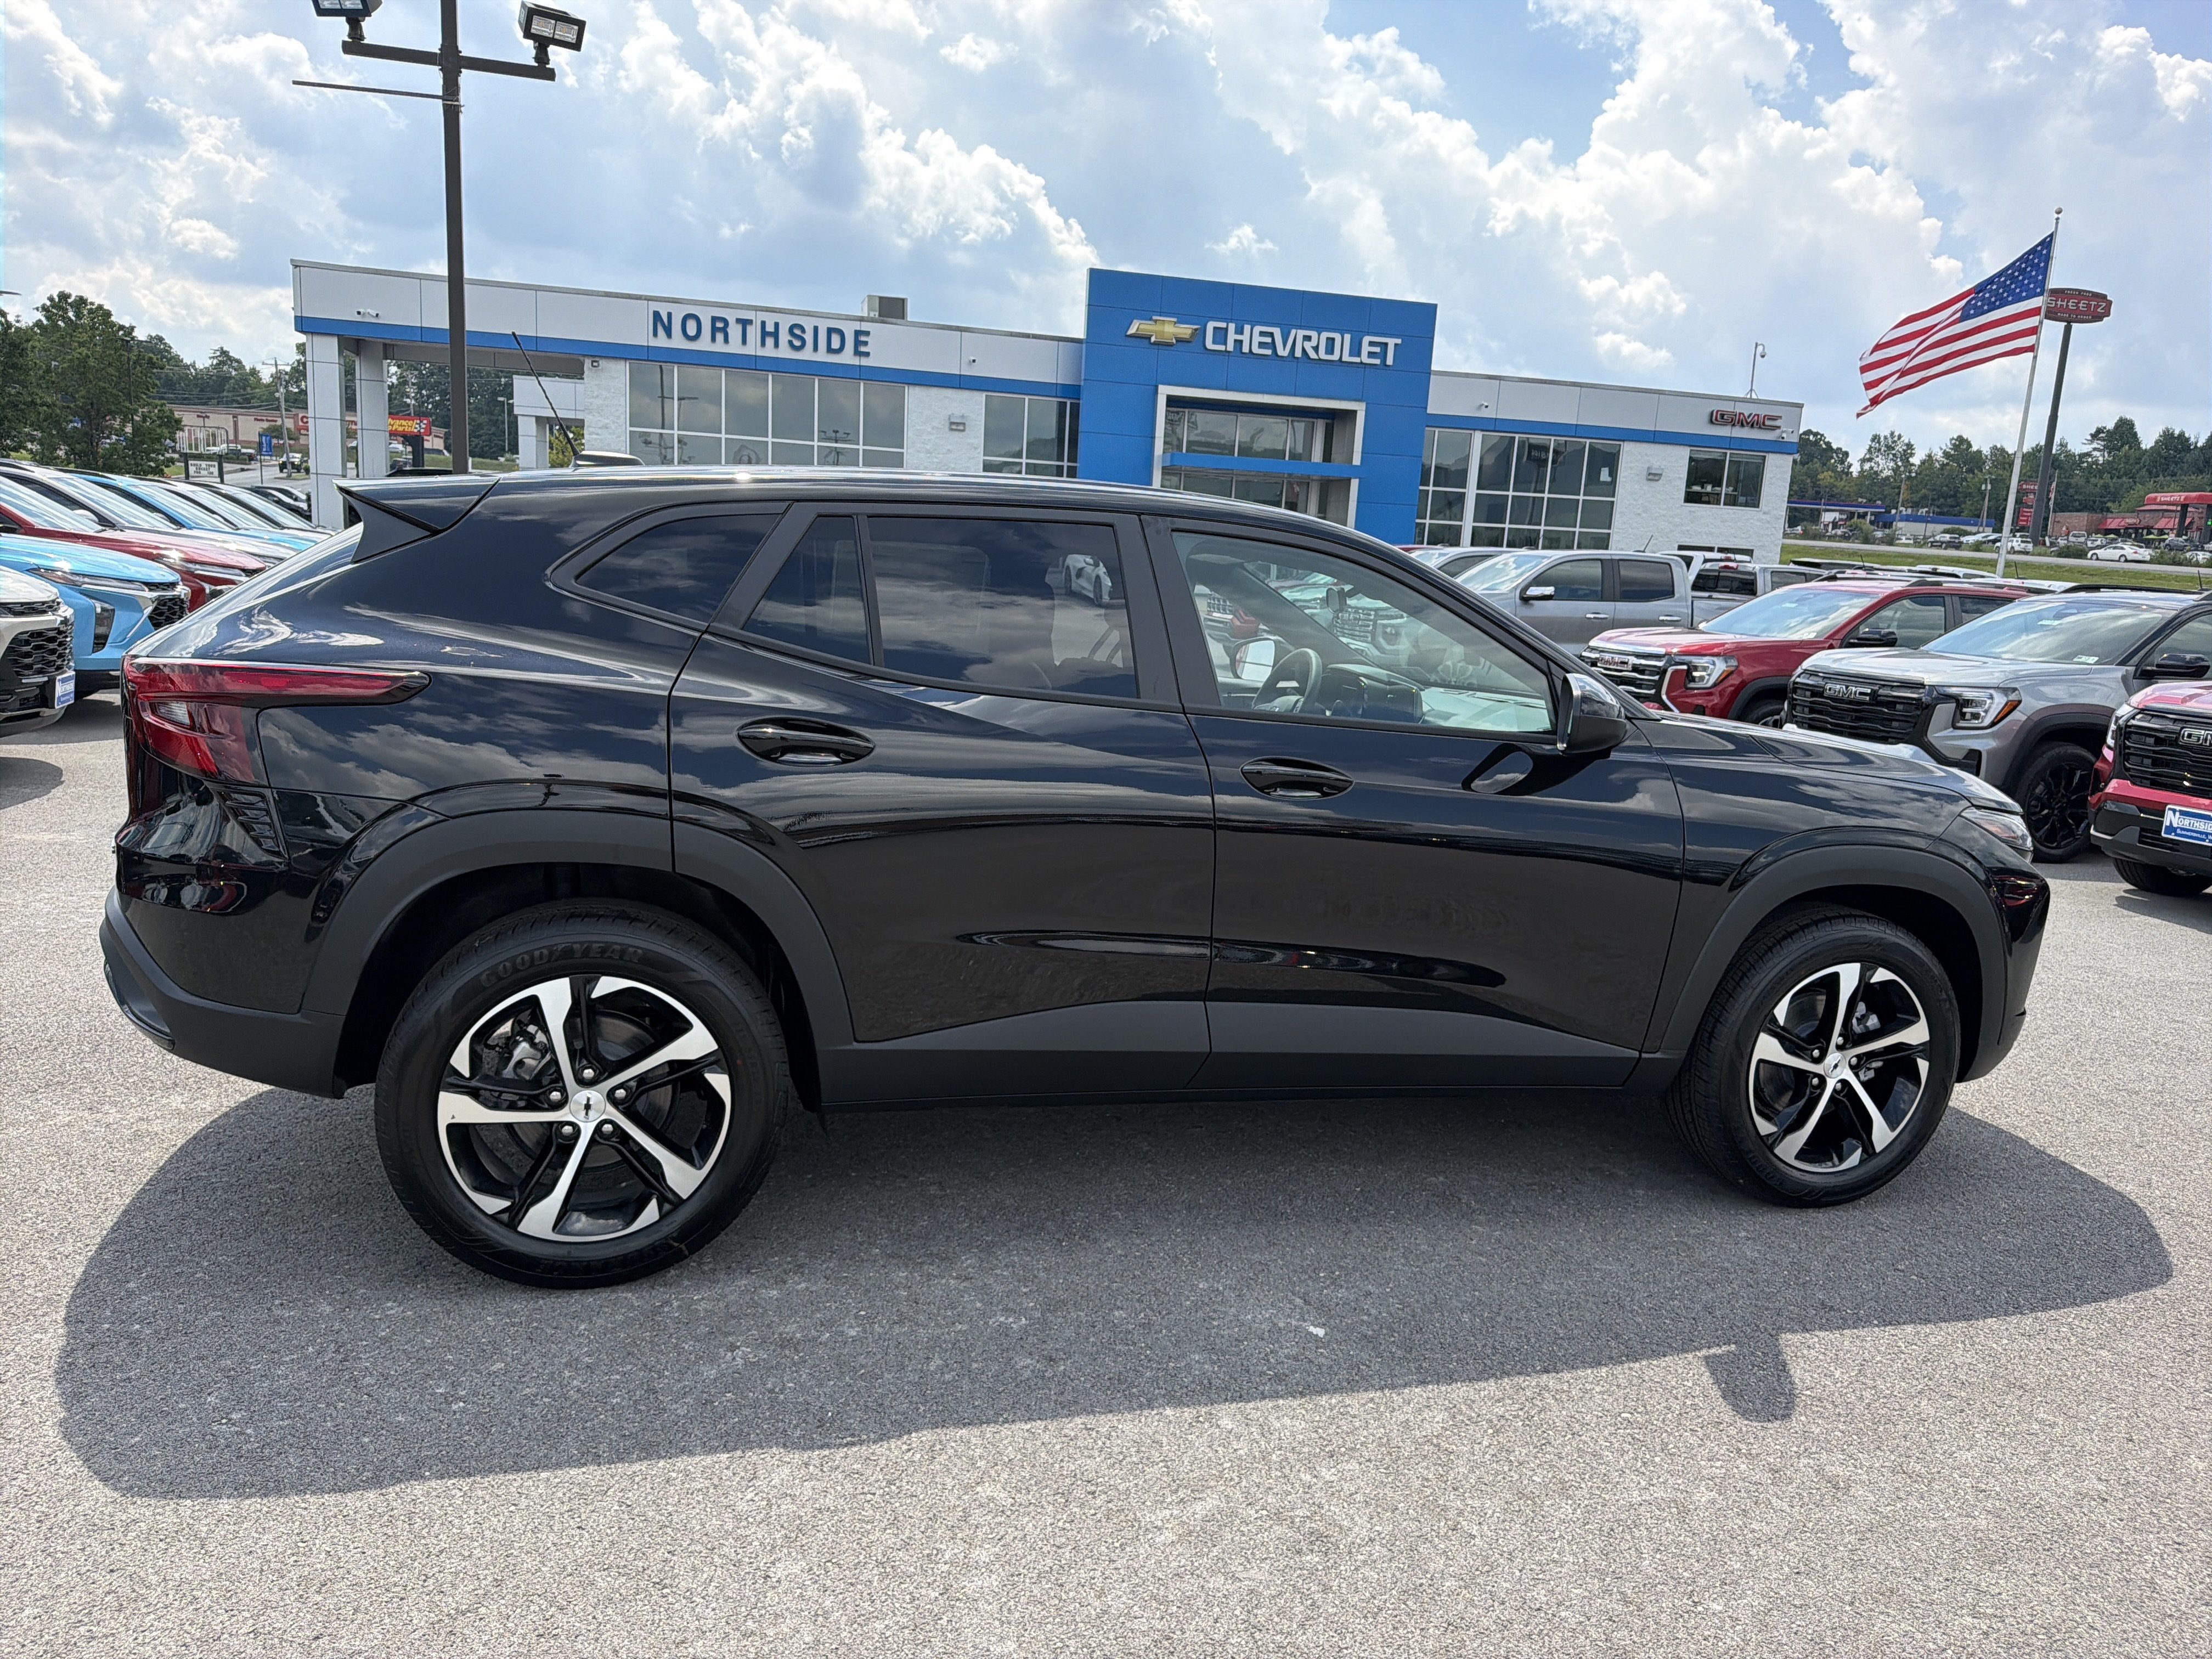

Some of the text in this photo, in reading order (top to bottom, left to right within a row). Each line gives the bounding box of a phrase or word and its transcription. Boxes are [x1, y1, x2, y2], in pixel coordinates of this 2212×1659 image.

[2047, 297, 2106, 313] SHEETZ
[652, 309, 871, 357] NORTHSIDE
[1205, 321, 1402, 365] CHEVROLET
[388, 417, 413, 426] vance
[1711, 409, 1782, 430] GMC
[1824, 683, 1871, 701] GMC
[480, 943, 643, 988] GOODYEAR
